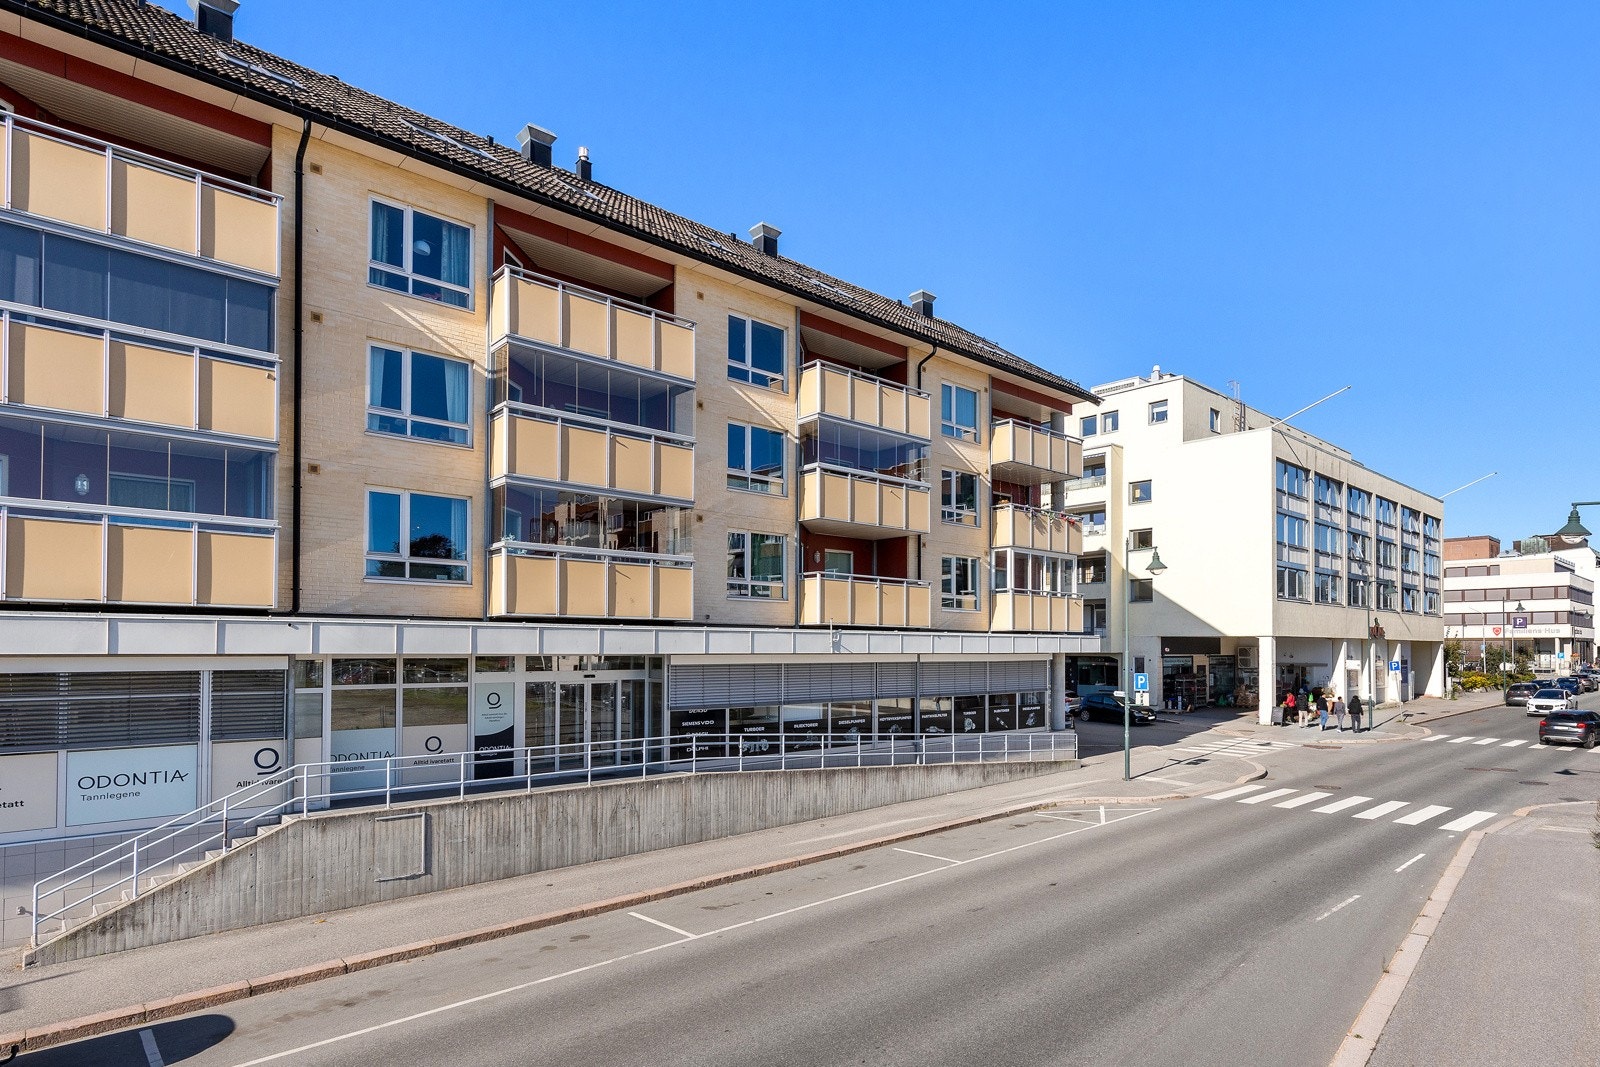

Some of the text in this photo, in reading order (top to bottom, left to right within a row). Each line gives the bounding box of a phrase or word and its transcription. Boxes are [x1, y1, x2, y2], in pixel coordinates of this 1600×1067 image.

[1137, 675, 1146, 688] P
[331, 765, 365, 773] annlegene
[77, 769, 189, 790] ODONTIA
[80, 790, 141, 803] Tannlegene
[0, 800, 24, 809] tatt
